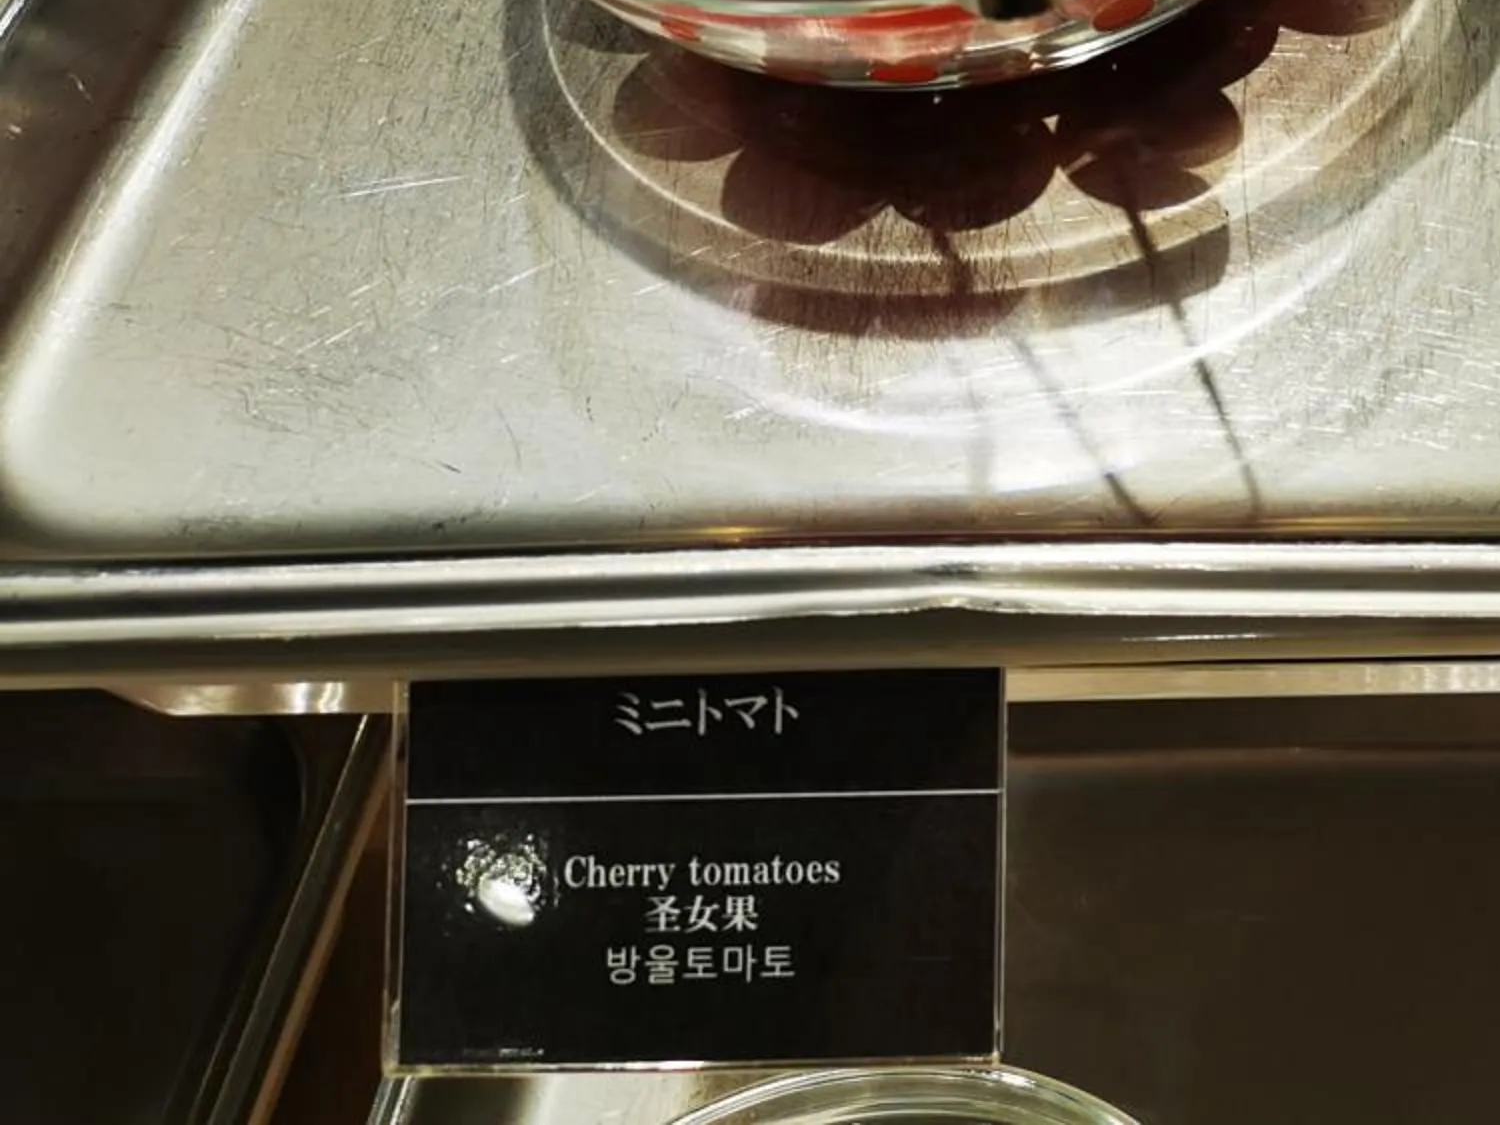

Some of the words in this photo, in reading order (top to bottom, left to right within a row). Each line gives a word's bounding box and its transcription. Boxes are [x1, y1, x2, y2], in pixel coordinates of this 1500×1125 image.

[614, 686, 800, 736] ミニトマト
[564, 856, 675, 890] Cherry
[689, 856, 839, 885] tomatoes
[644, 894, 759, 933] 圣女果
[608, 945, 794, 984] 방울토마토
